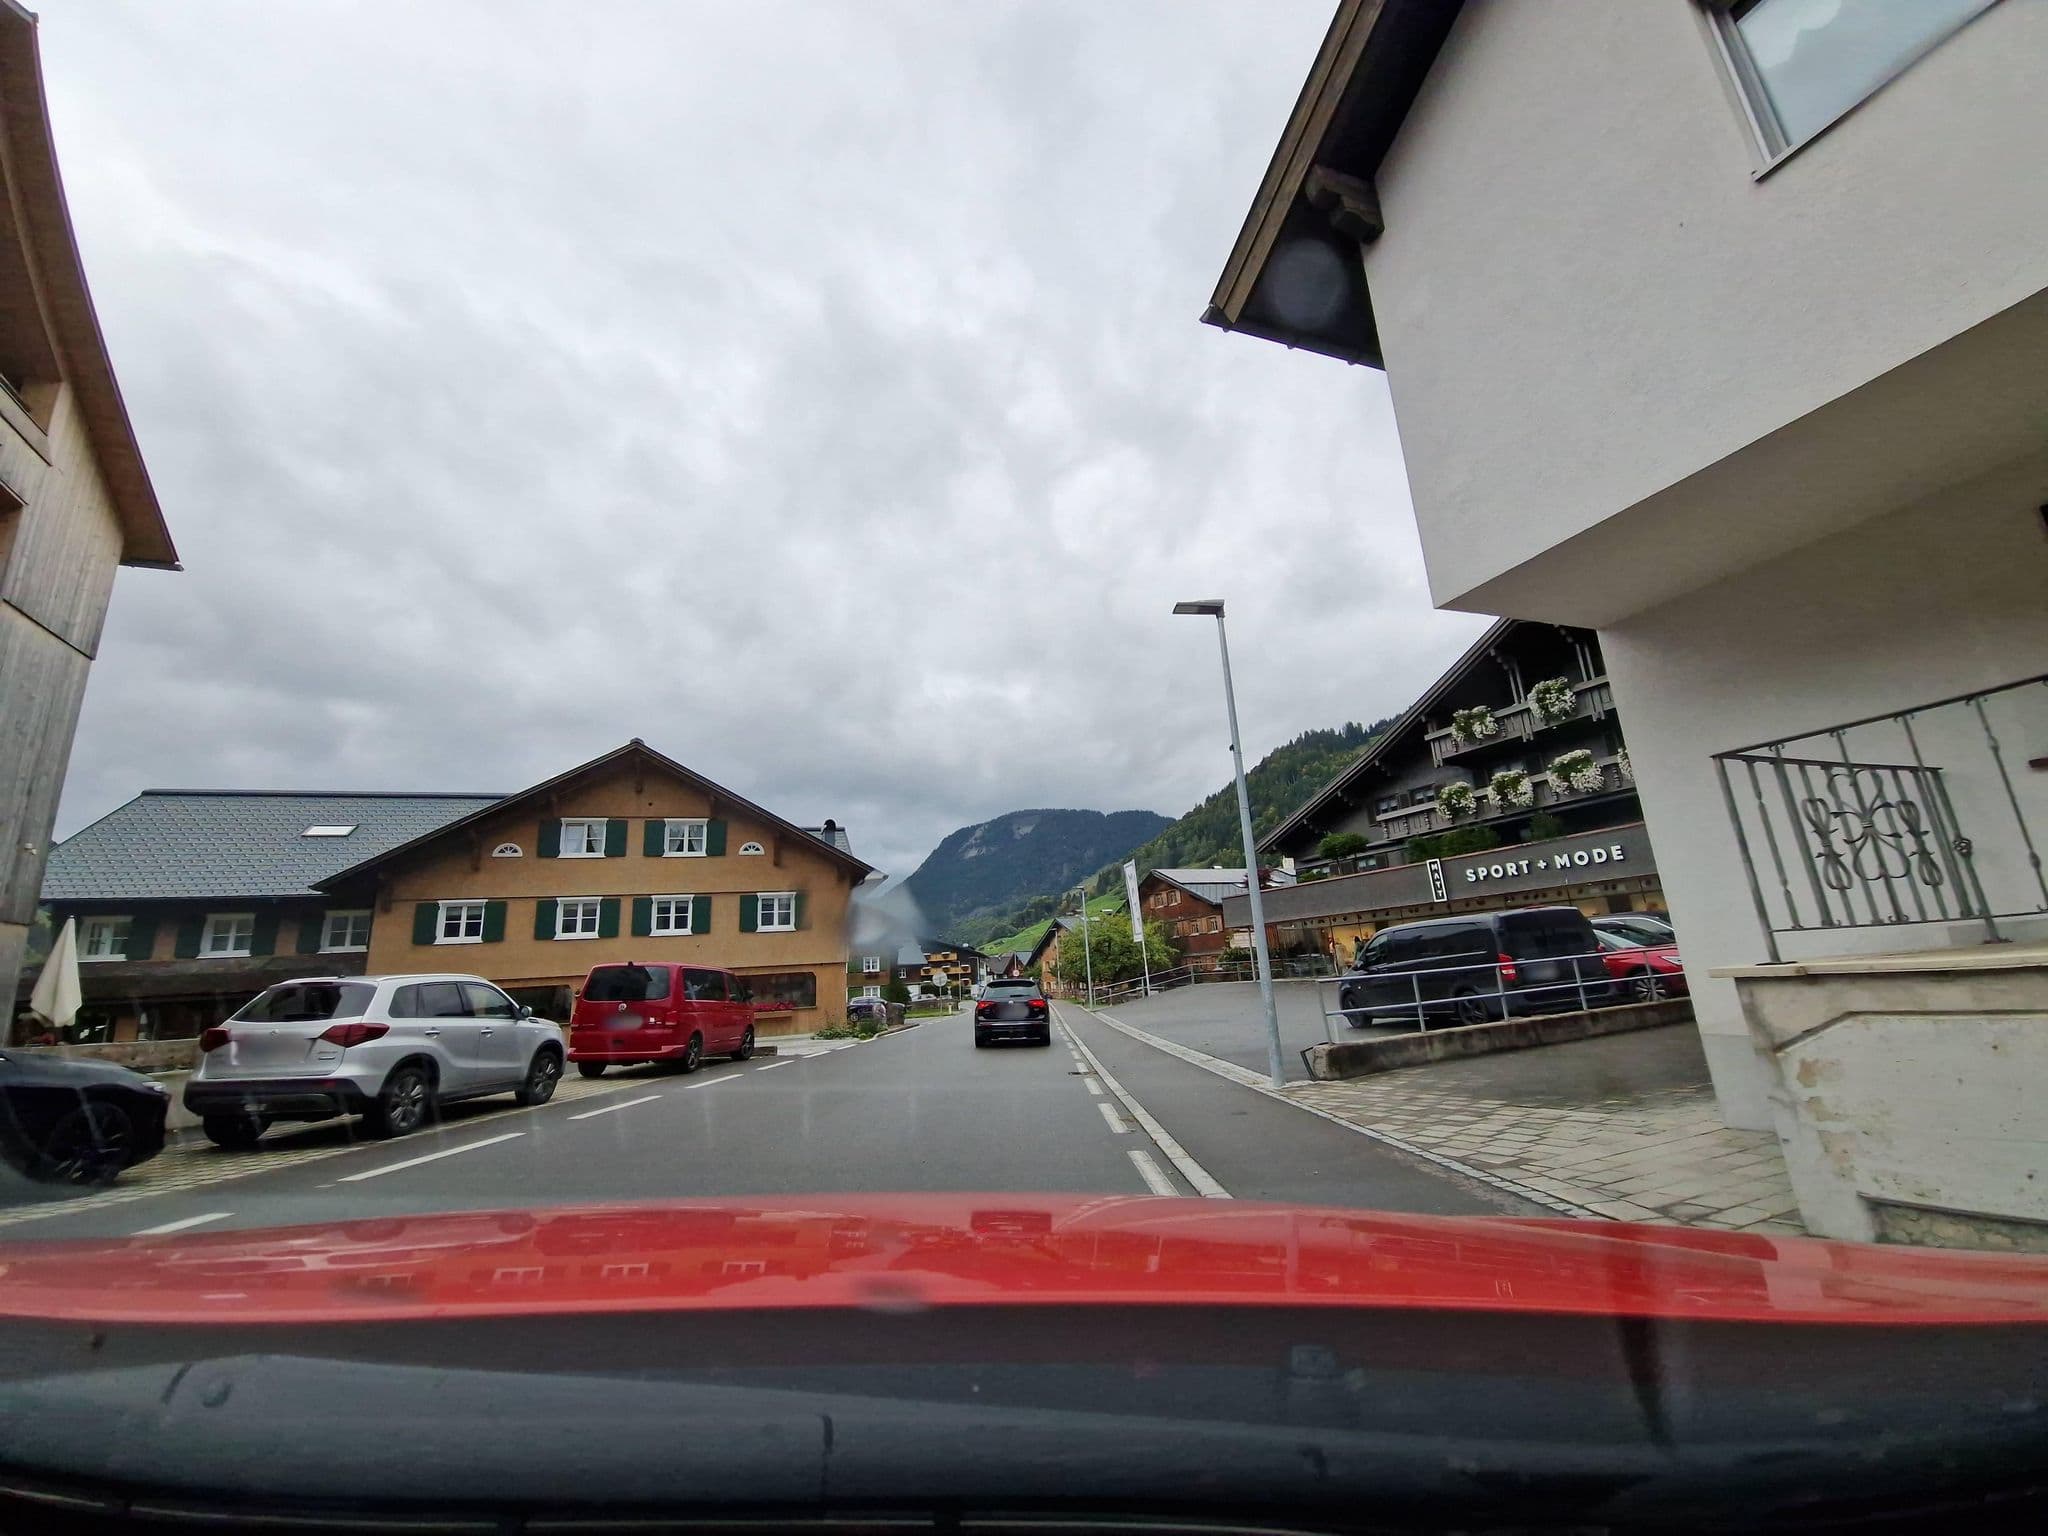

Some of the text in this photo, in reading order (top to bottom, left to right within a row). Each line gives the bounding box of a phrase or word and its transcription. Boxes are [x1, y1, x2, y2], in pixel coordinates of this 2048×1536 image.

[1430, 863, 1443, 897] MATT
[1465, 844, 1625, 882] SPORT + MODE
